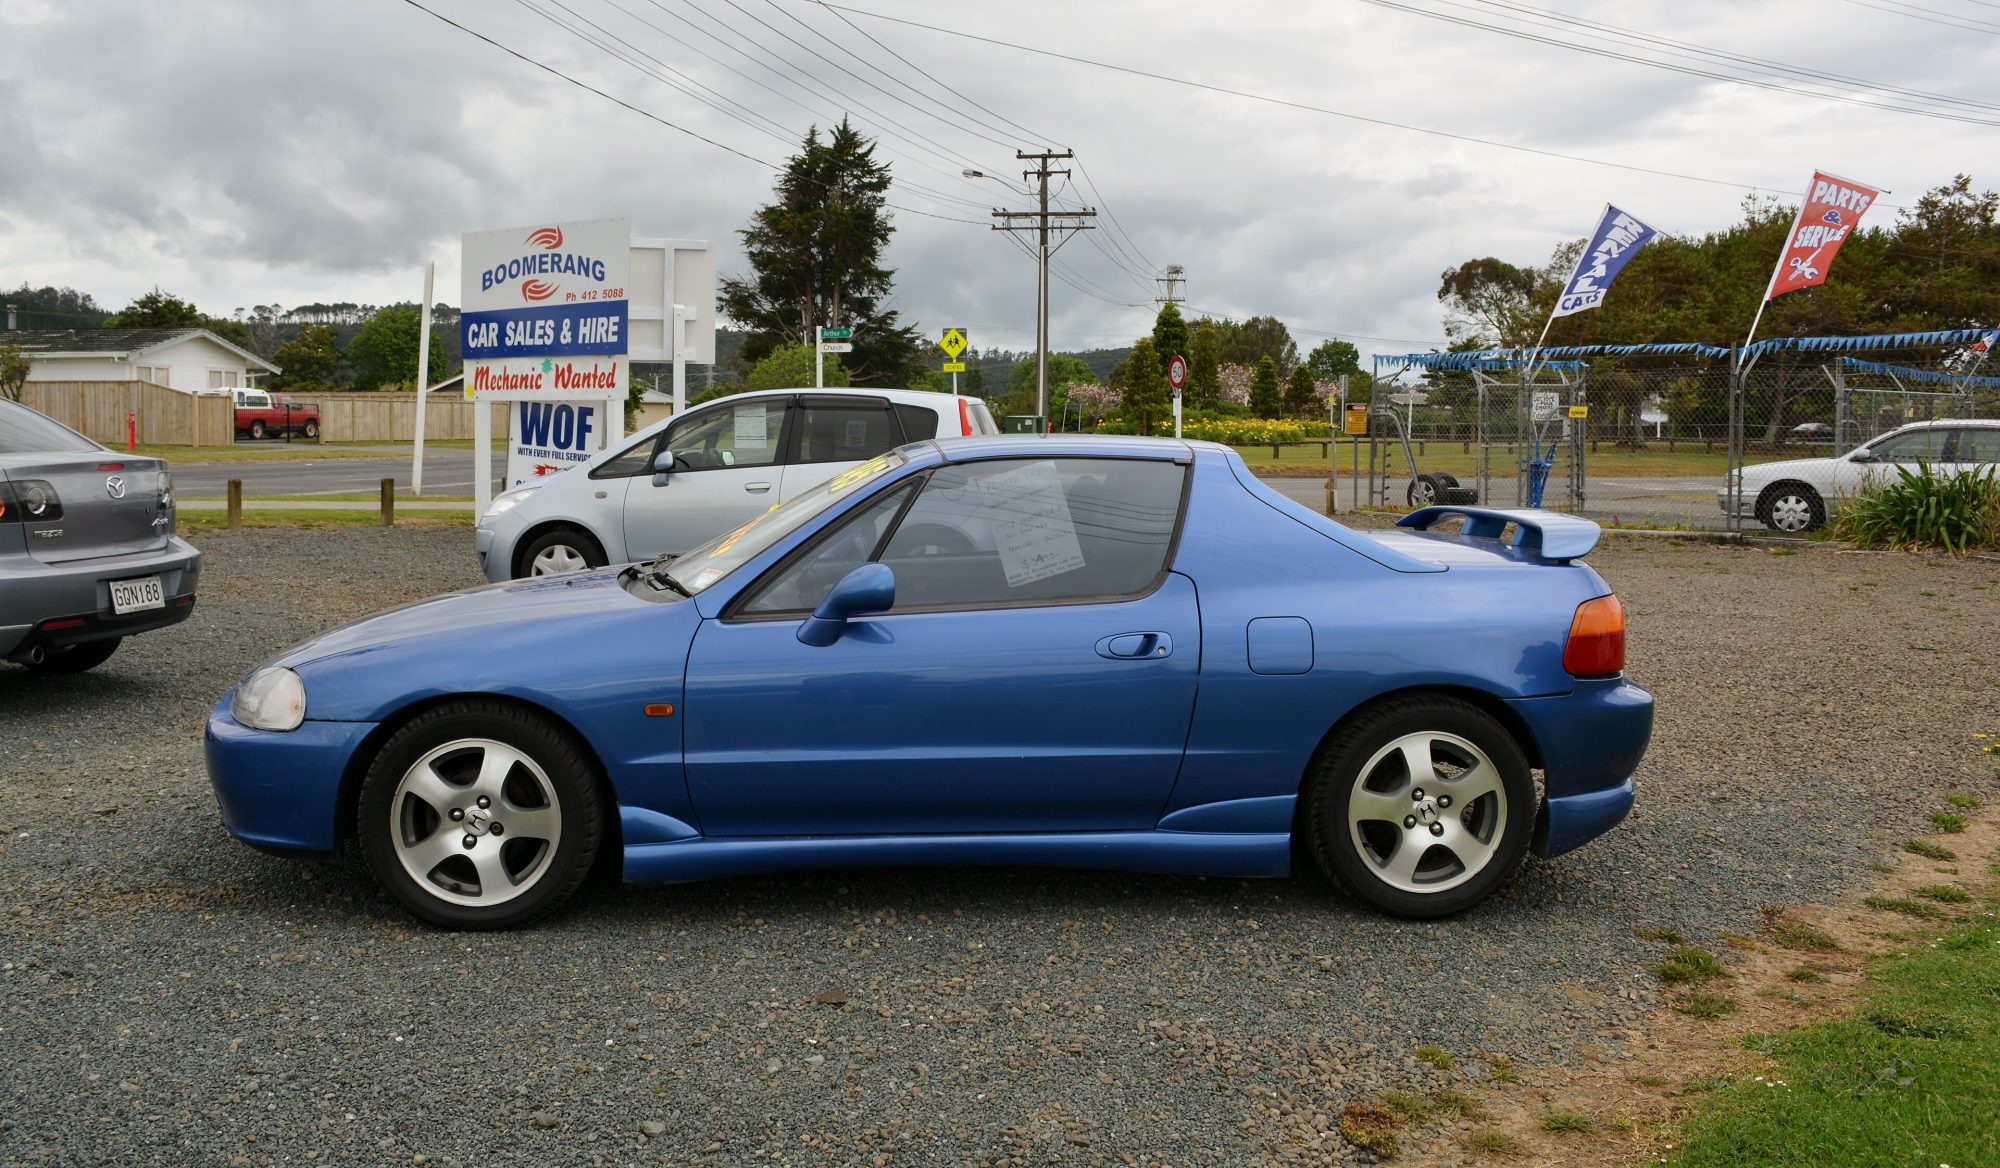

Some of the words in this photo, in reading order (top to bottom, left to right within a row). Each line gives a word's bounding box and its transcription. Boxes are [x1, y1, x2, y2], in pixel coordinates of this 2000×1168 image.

[1811, 181, 1870, 214] PARTS
[1822, 210, 1841, 225] &
[1793, 224, 1849, 250] SERVE
[1572, 213, 1644, 294] RENTAL
[482, 253, 605, 292] BOOMERANG
[566, 292, 576, 302] Ph
[581, 290, 597, 300] 412
[602, 288, 624, 299] 5088
[468, 322, 498, 348] CAR
[505, 319, 555, 347] SALES
[560, 318, 572, 345] &
[578, 316, 620, 344] HIRE
[474, 366, 542, 391] Mechanic
[554, 362, 617, 389] Wanted
[1172, 366, 1182, 379] 50
[520, 401, 594, 451] WOF
[517, 447, 532, 457] WITH
[533, 449, 550, 459] EVERY
[552, 450, 565, 460] FULL
[114, 583, 160, 608] GQN188
